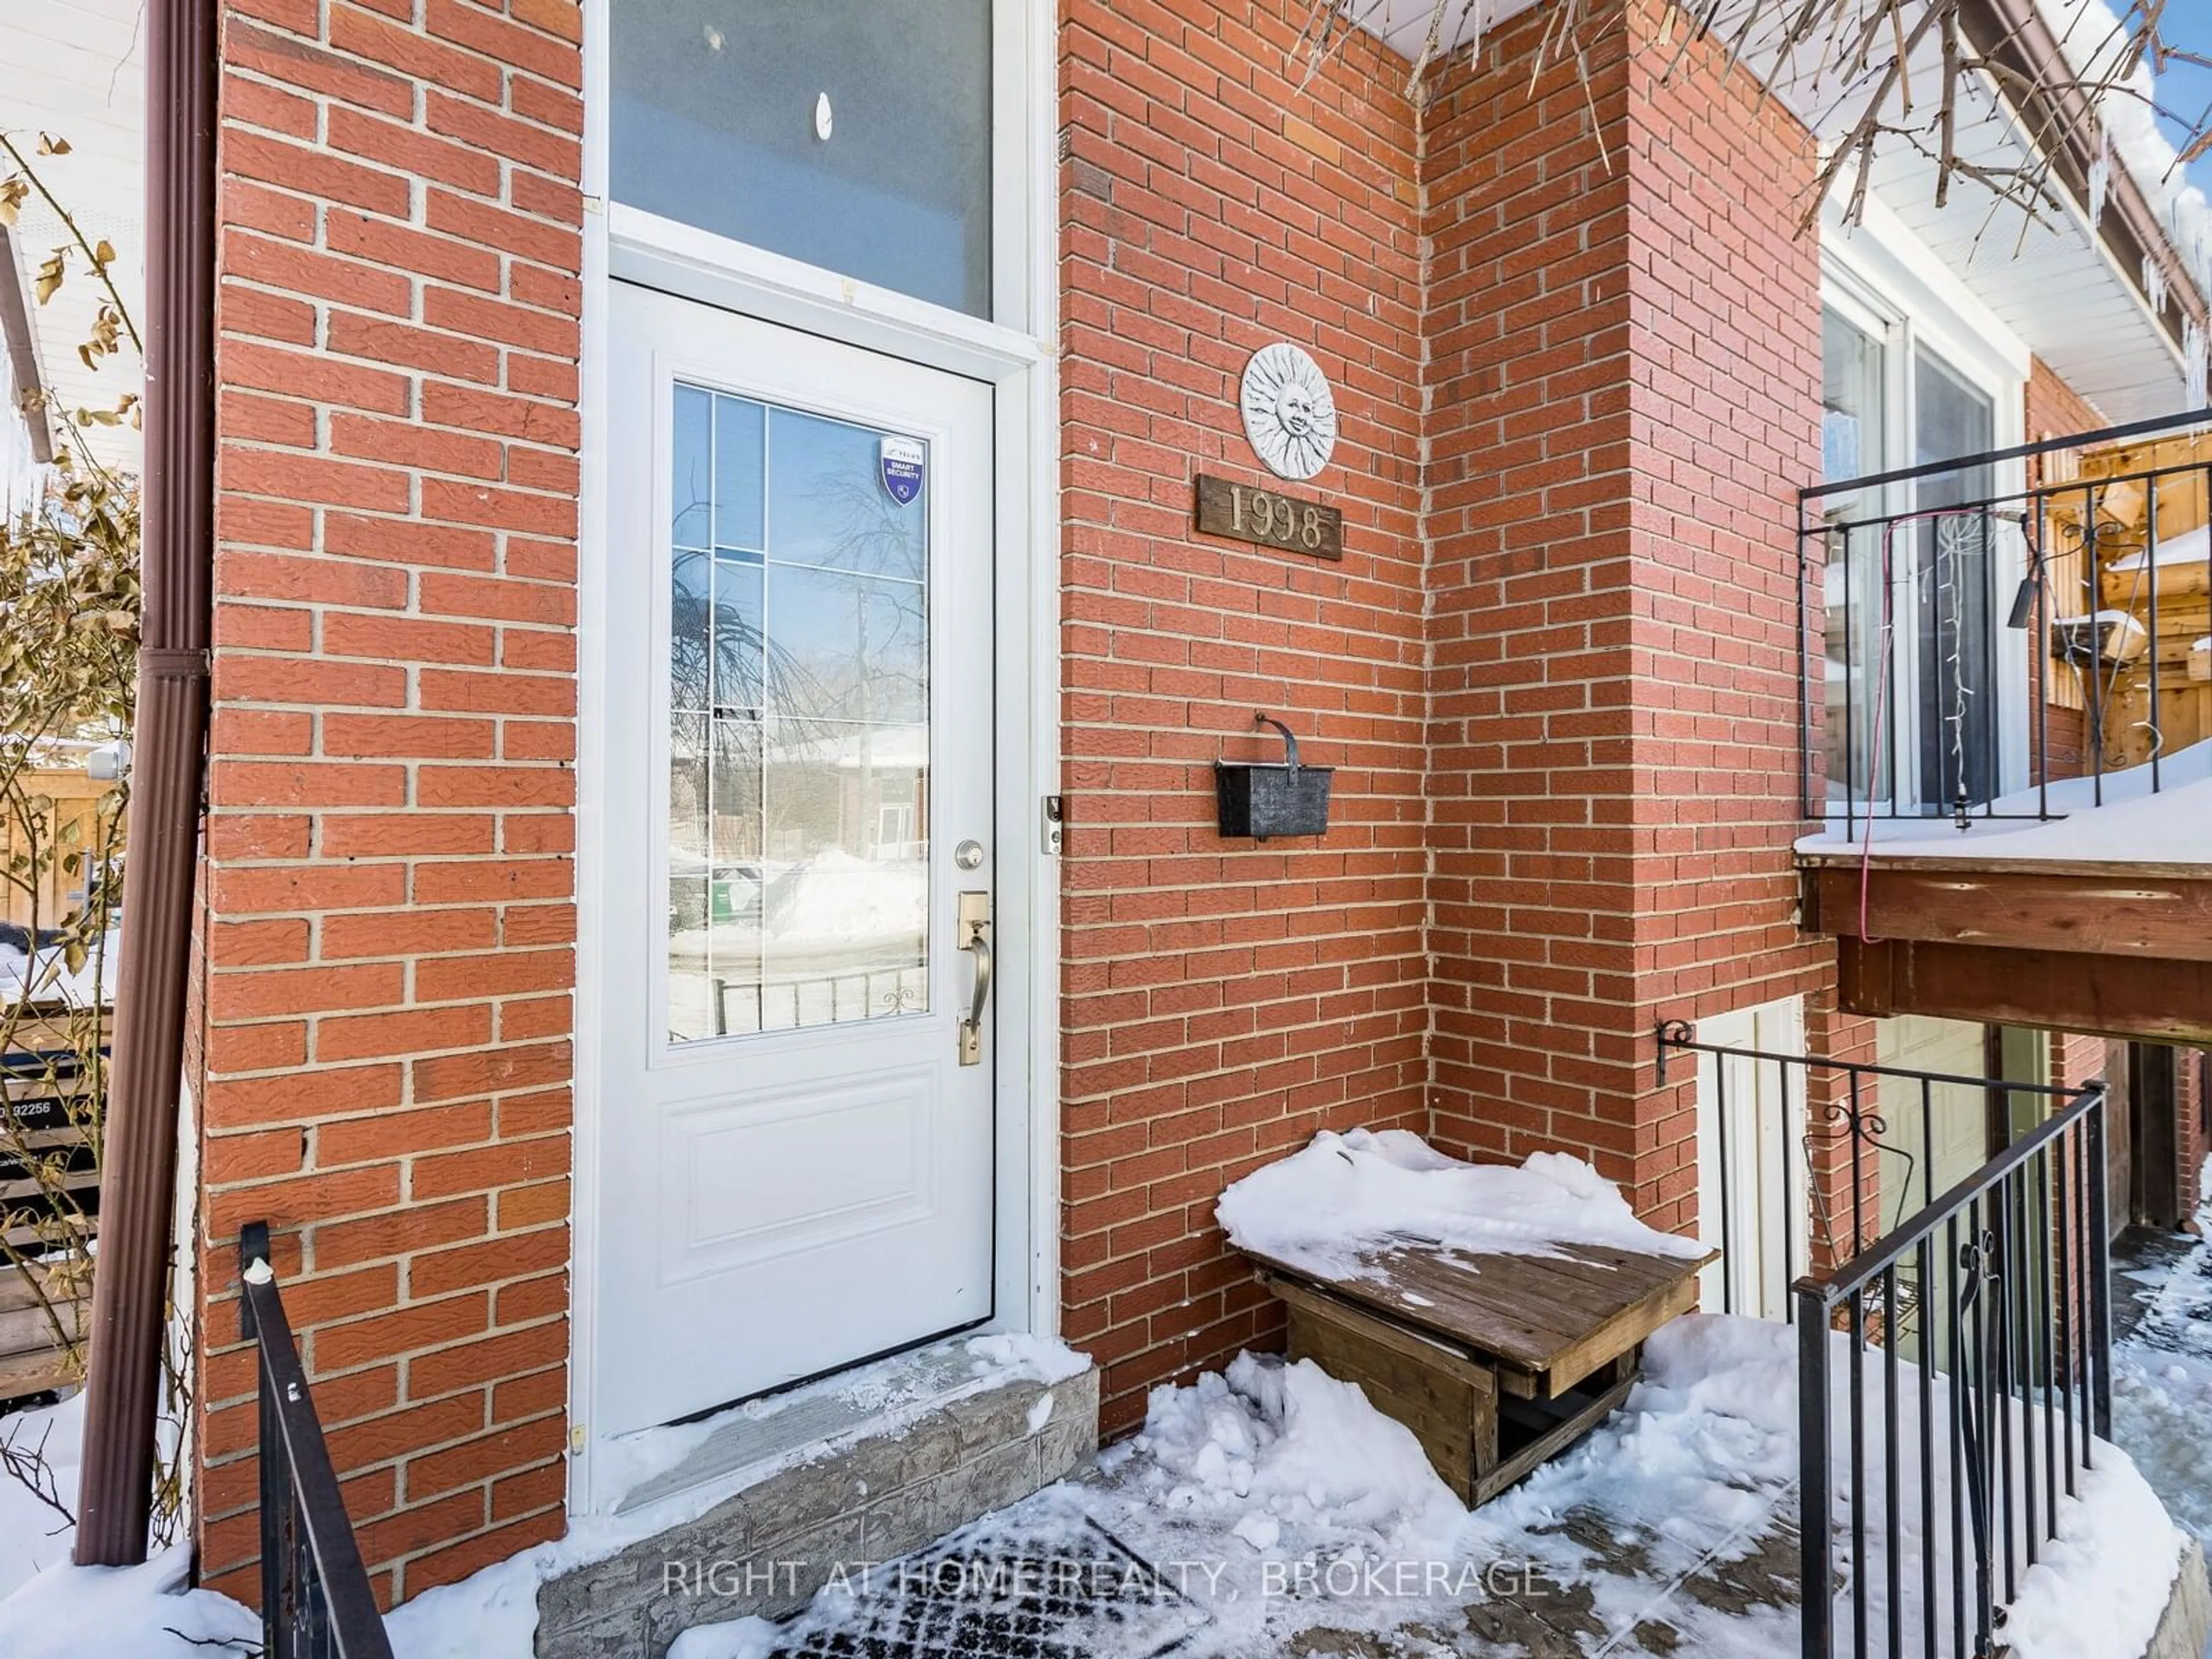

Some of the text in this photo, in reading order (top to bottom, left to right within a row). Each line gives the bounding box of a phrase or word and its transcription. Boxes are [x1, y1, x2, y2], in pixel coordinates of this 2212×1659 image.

[891, 462, 915, 471] SMART
[887, 468, 919, 479] SECURITY
[1230, 485, 1321, 549] 1998
